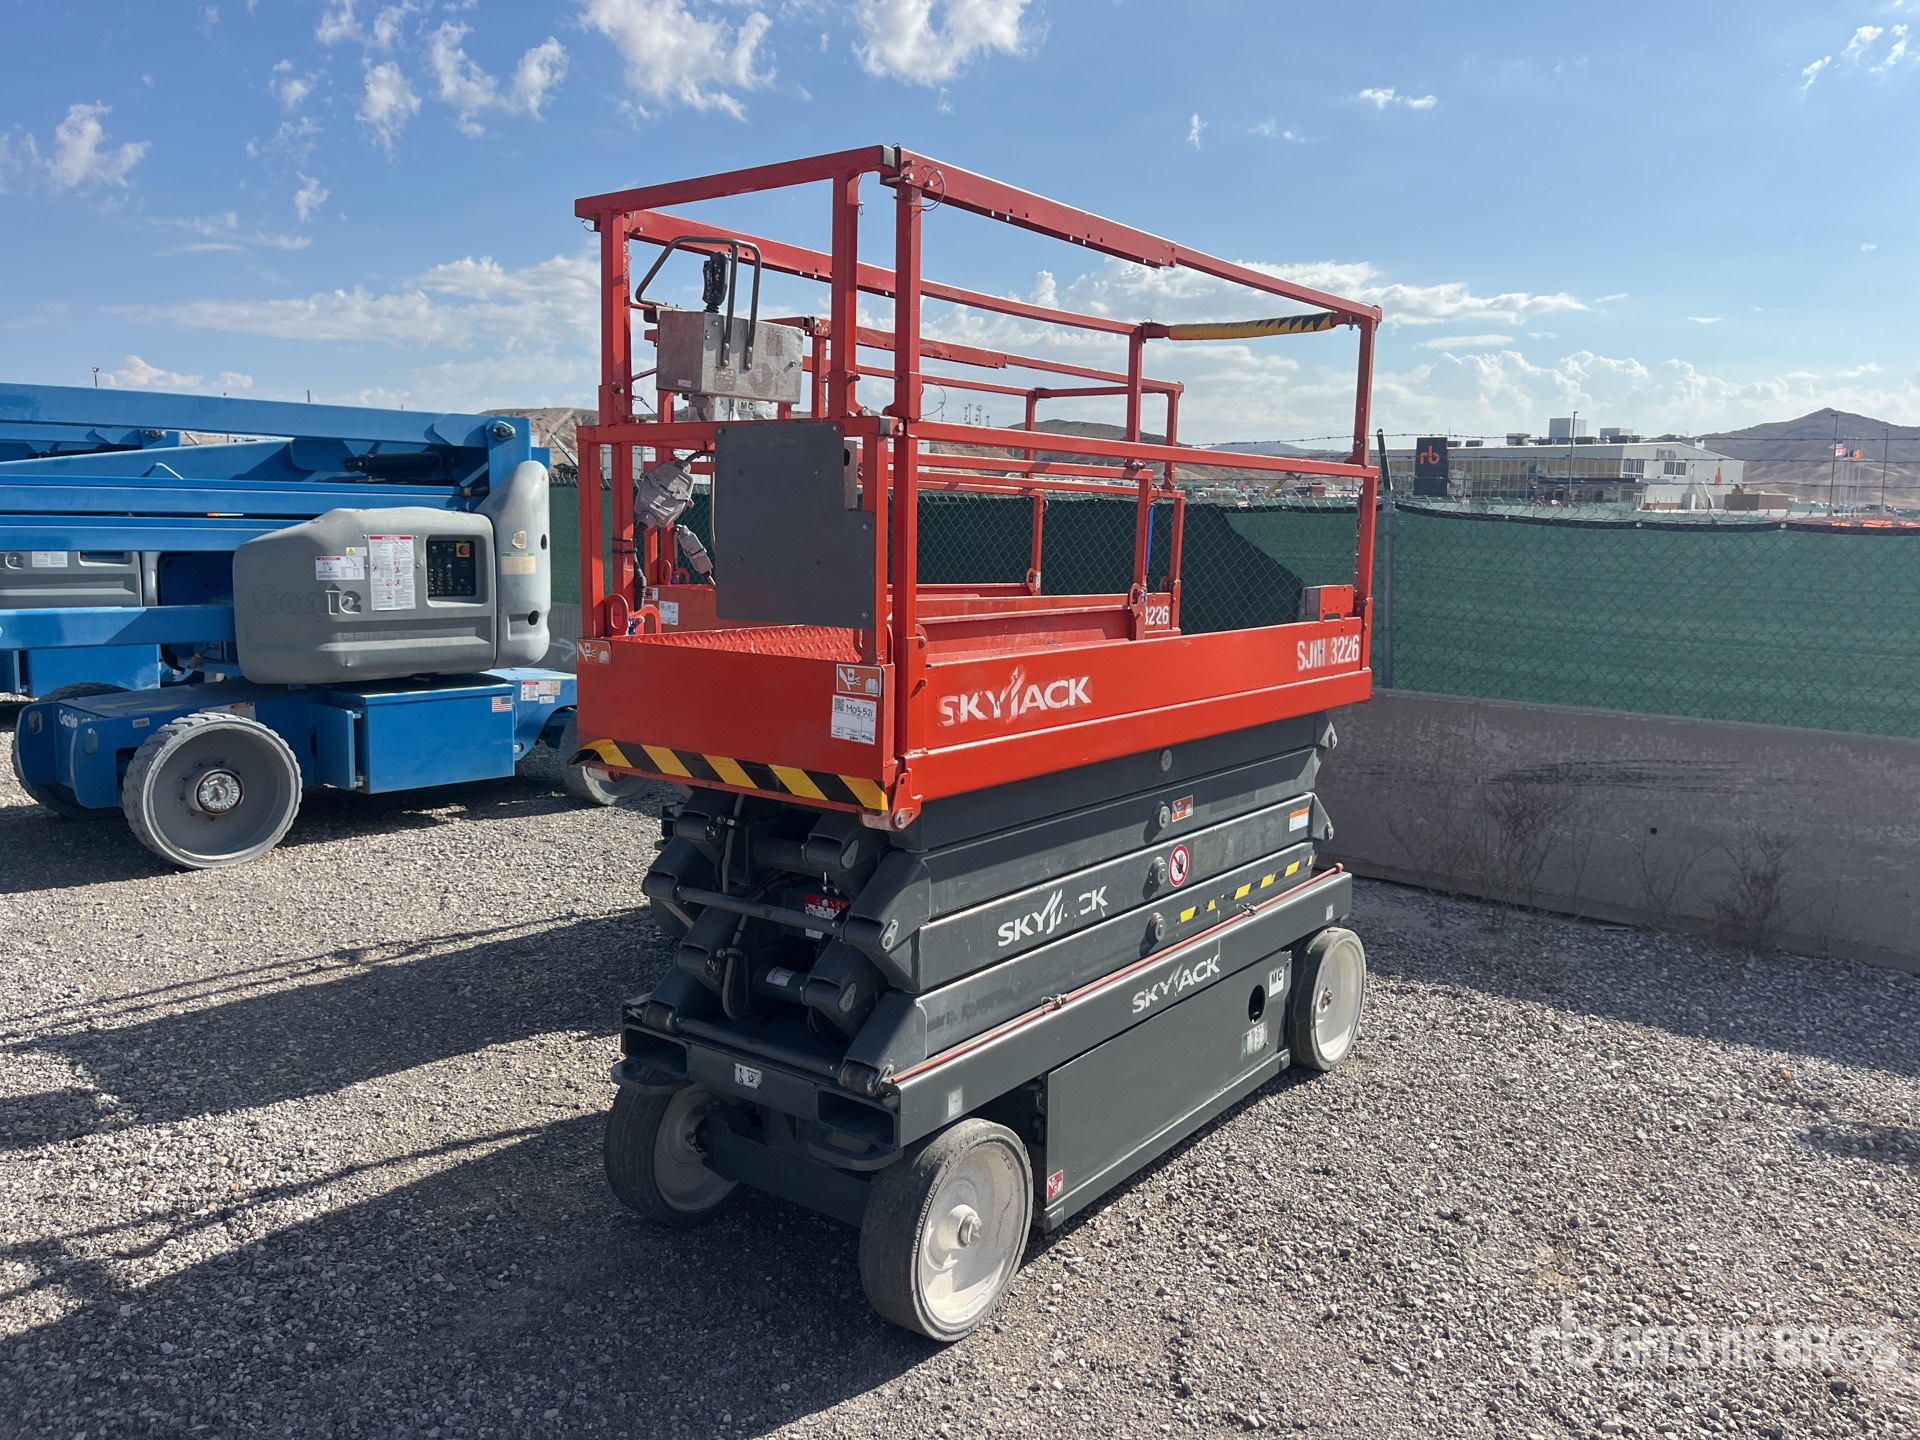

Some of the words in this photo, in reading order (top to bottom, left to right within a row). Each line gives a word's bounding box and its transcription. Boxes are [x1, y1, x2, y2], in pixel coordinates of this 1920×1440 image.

[740, 401, 754, 411] MC
[1420, 445, 1441, 465] rb
[252, 583, 362, 617] Genie
[1330, 634, 1360, 665] 3226
[936, 665, 1092, 727] SKYJACK
[1271, 969, 1283, 985] MC
